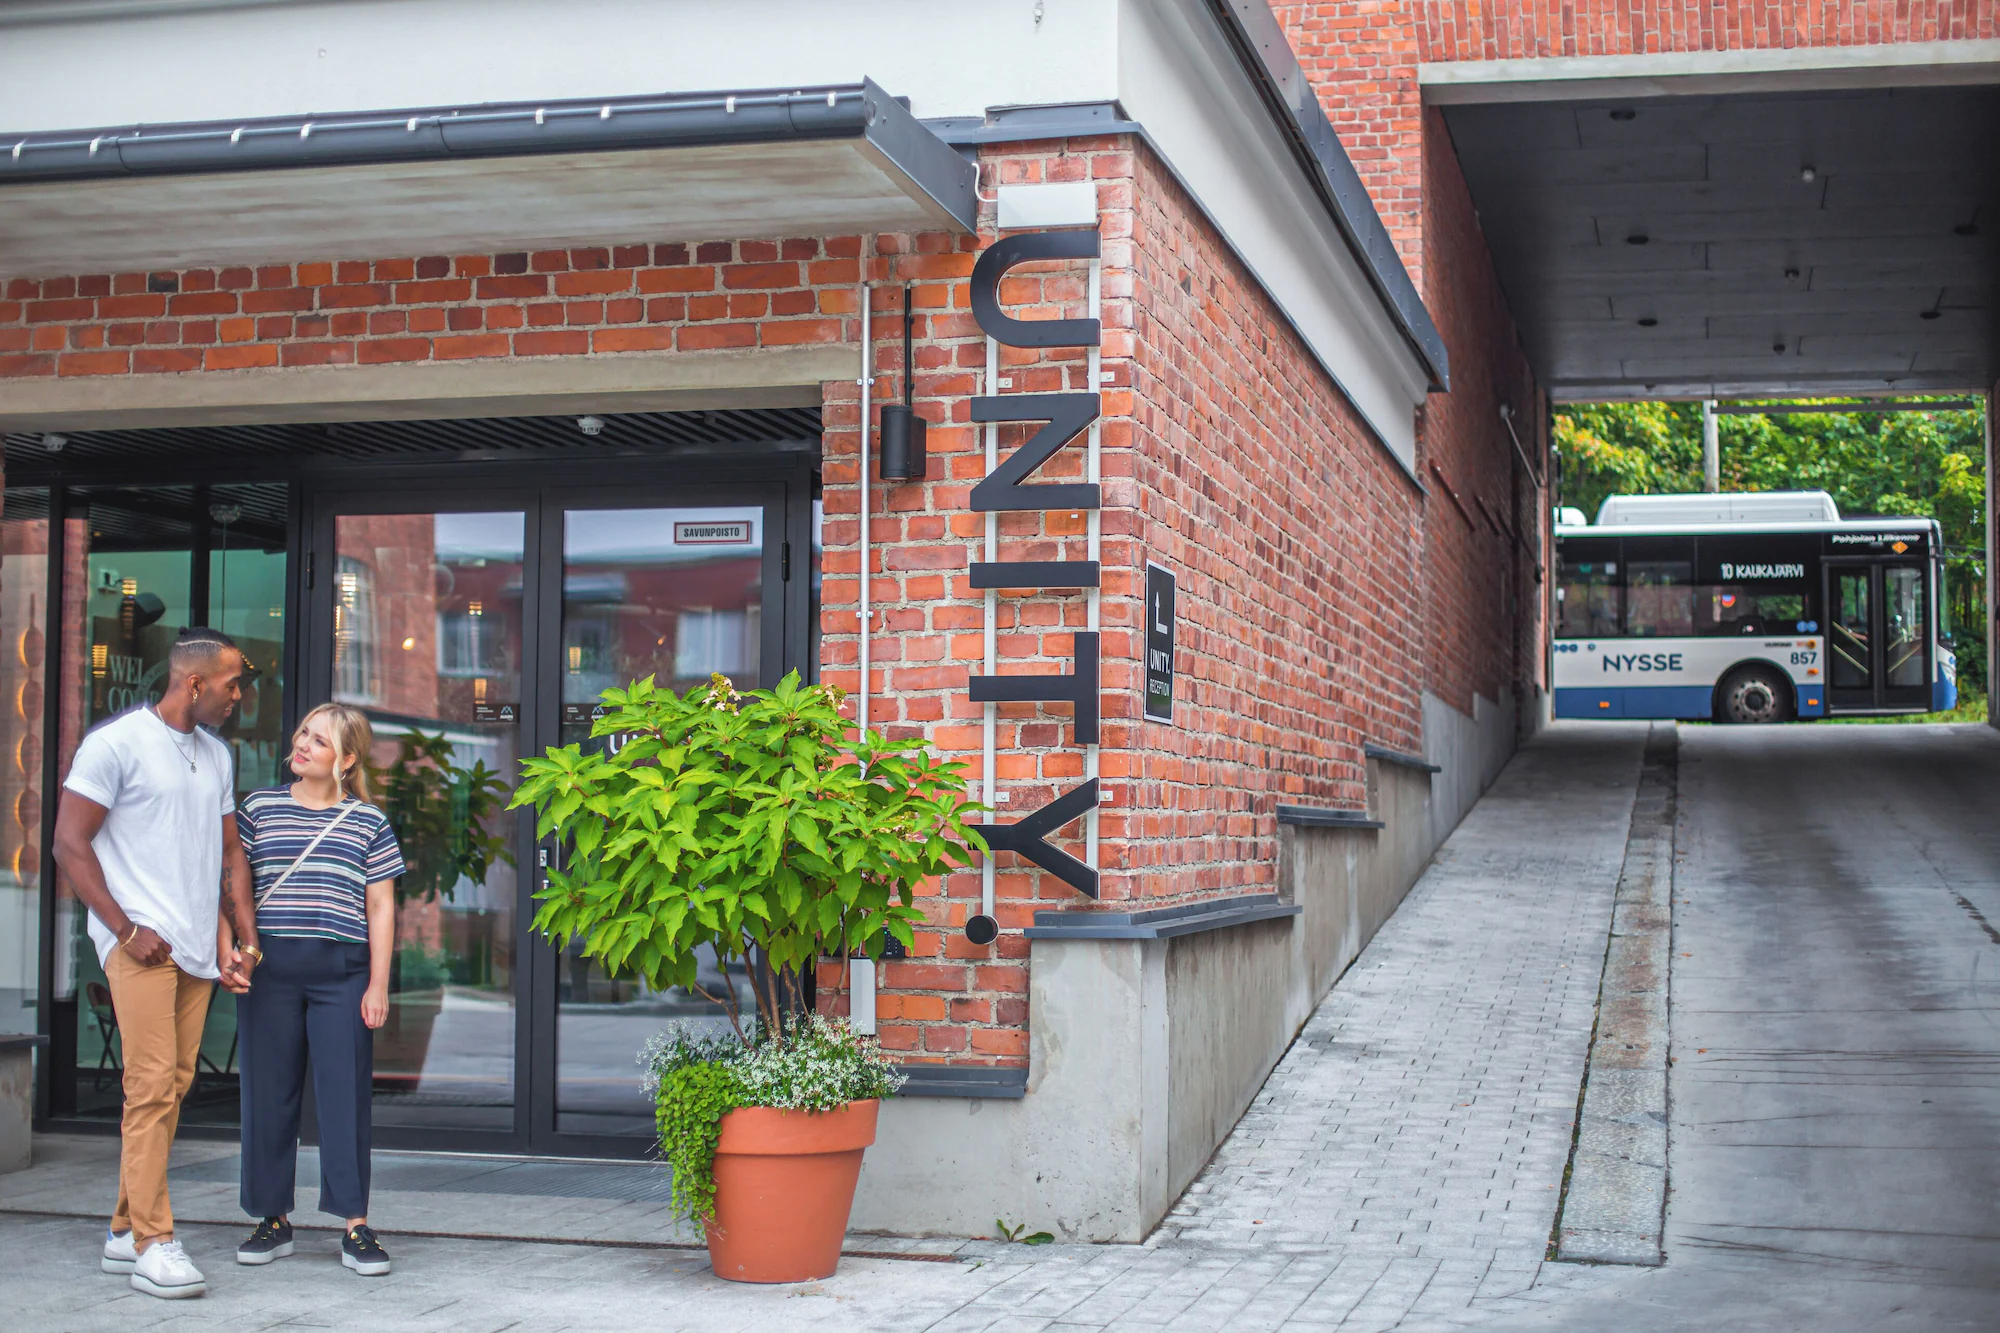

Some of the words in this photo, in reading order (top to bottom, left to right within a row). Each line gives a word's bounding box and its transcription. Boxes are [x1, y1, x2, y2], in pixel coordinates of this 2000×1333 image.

[683, 527, 741, 538] SAVUNPOISTO
[1721, 562, 1734, 580] 10
[1603, 653, 1683, 672] NYSSE
[1790, 651, 1817, 665] 857
[1149, 678, 1170, 698] RECEPTION
